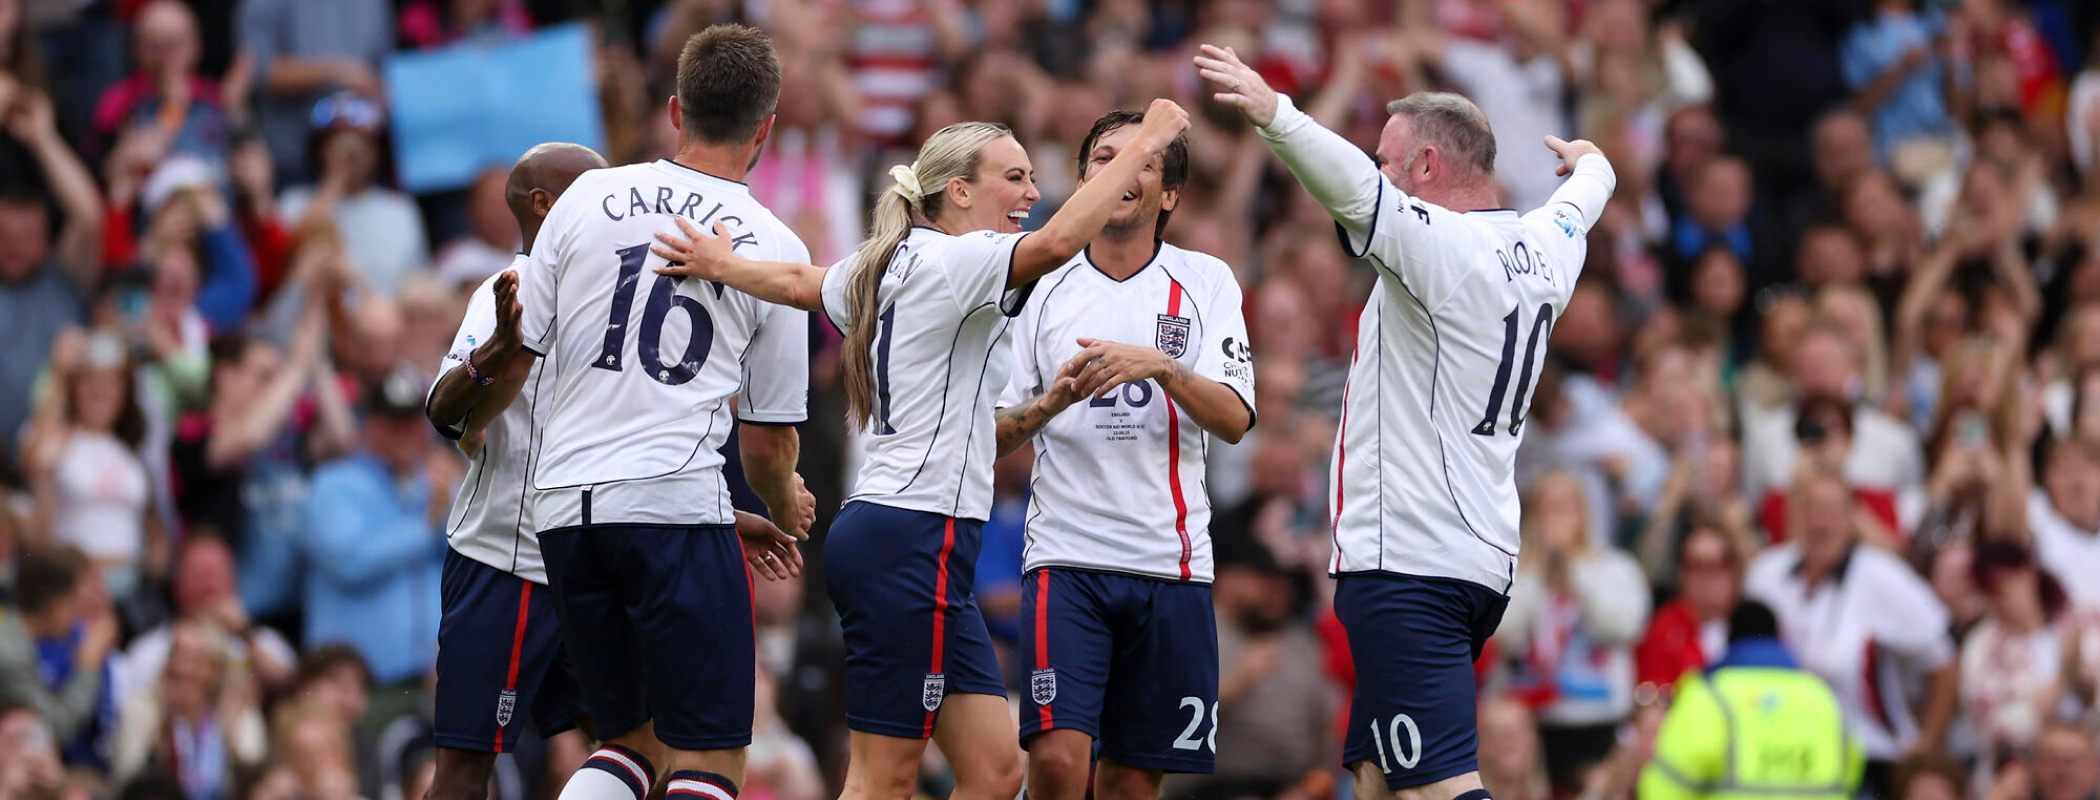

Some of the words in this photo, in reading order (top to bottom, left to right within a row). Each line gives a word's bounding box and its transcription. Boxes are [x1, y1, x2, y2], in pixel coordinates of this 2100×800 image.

[602, 186, 759, 253] CARRICK
[591, 241, 715, 386] 16
[1470, 302, 1554, 437] 10
[1370, 713, 1422, 774] 10
